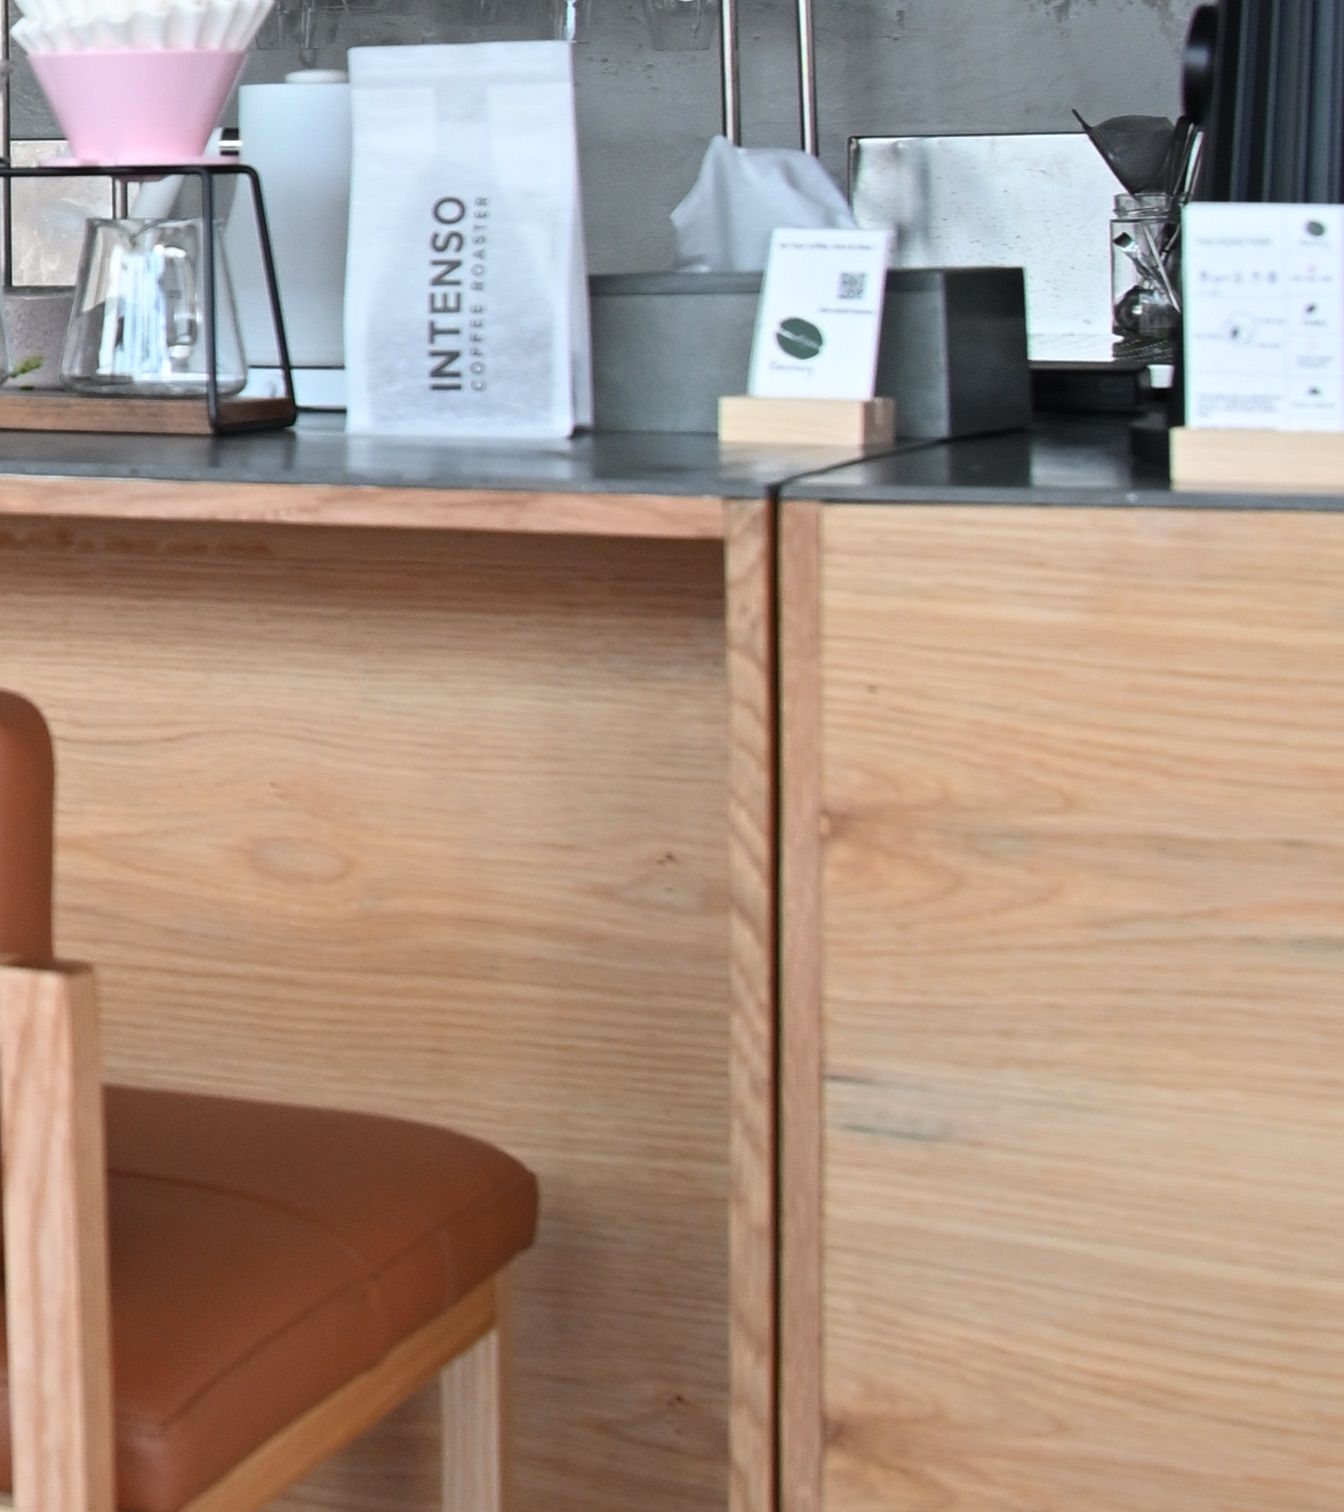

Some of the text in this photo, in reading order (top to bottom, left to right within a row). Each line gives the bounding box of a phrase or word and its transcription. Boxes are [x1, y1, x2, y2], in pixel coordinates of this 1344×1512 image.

[428, 195, 466, 391] INTENSO
[469, 196, 489, 392] COFFEE ROASTER
